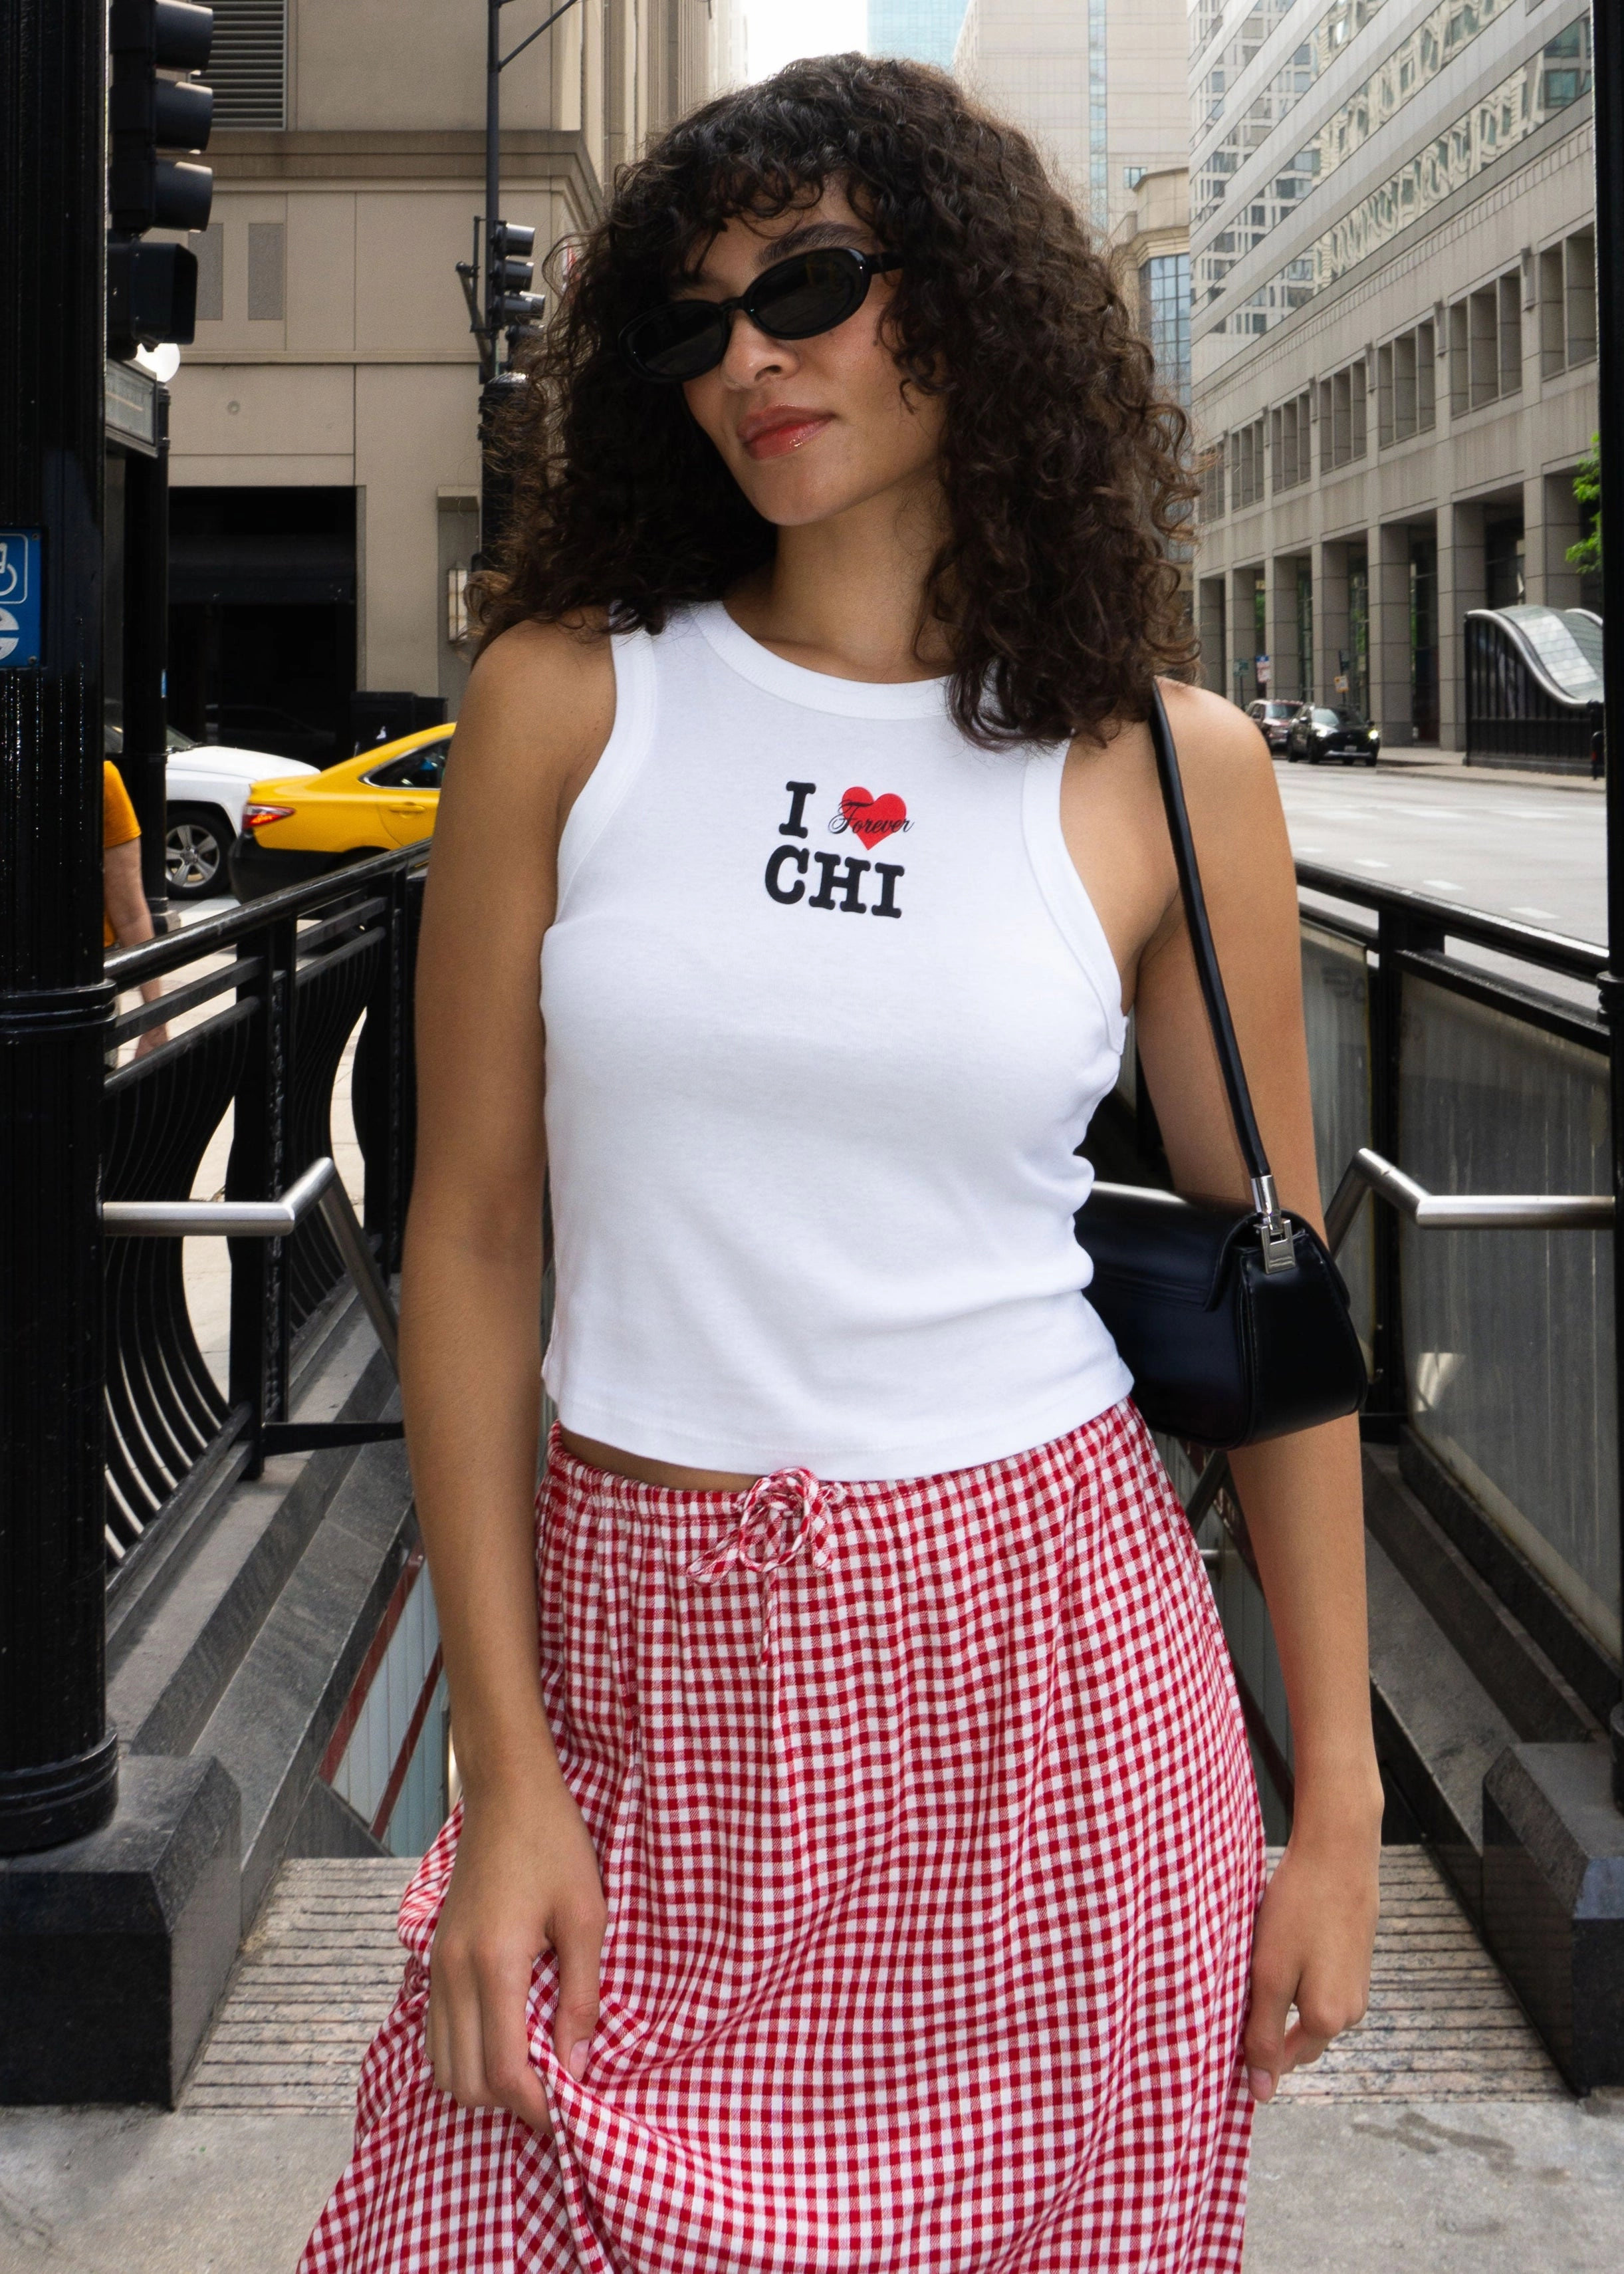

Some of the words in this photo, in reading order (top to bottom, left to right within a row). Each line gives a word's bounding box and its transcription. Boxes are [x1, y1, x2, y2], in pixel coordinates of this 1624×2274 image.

[778, 781, 816, 838] I
[828, 799, 915, 834] Forever
[765, 844, 905, 918] CHI
